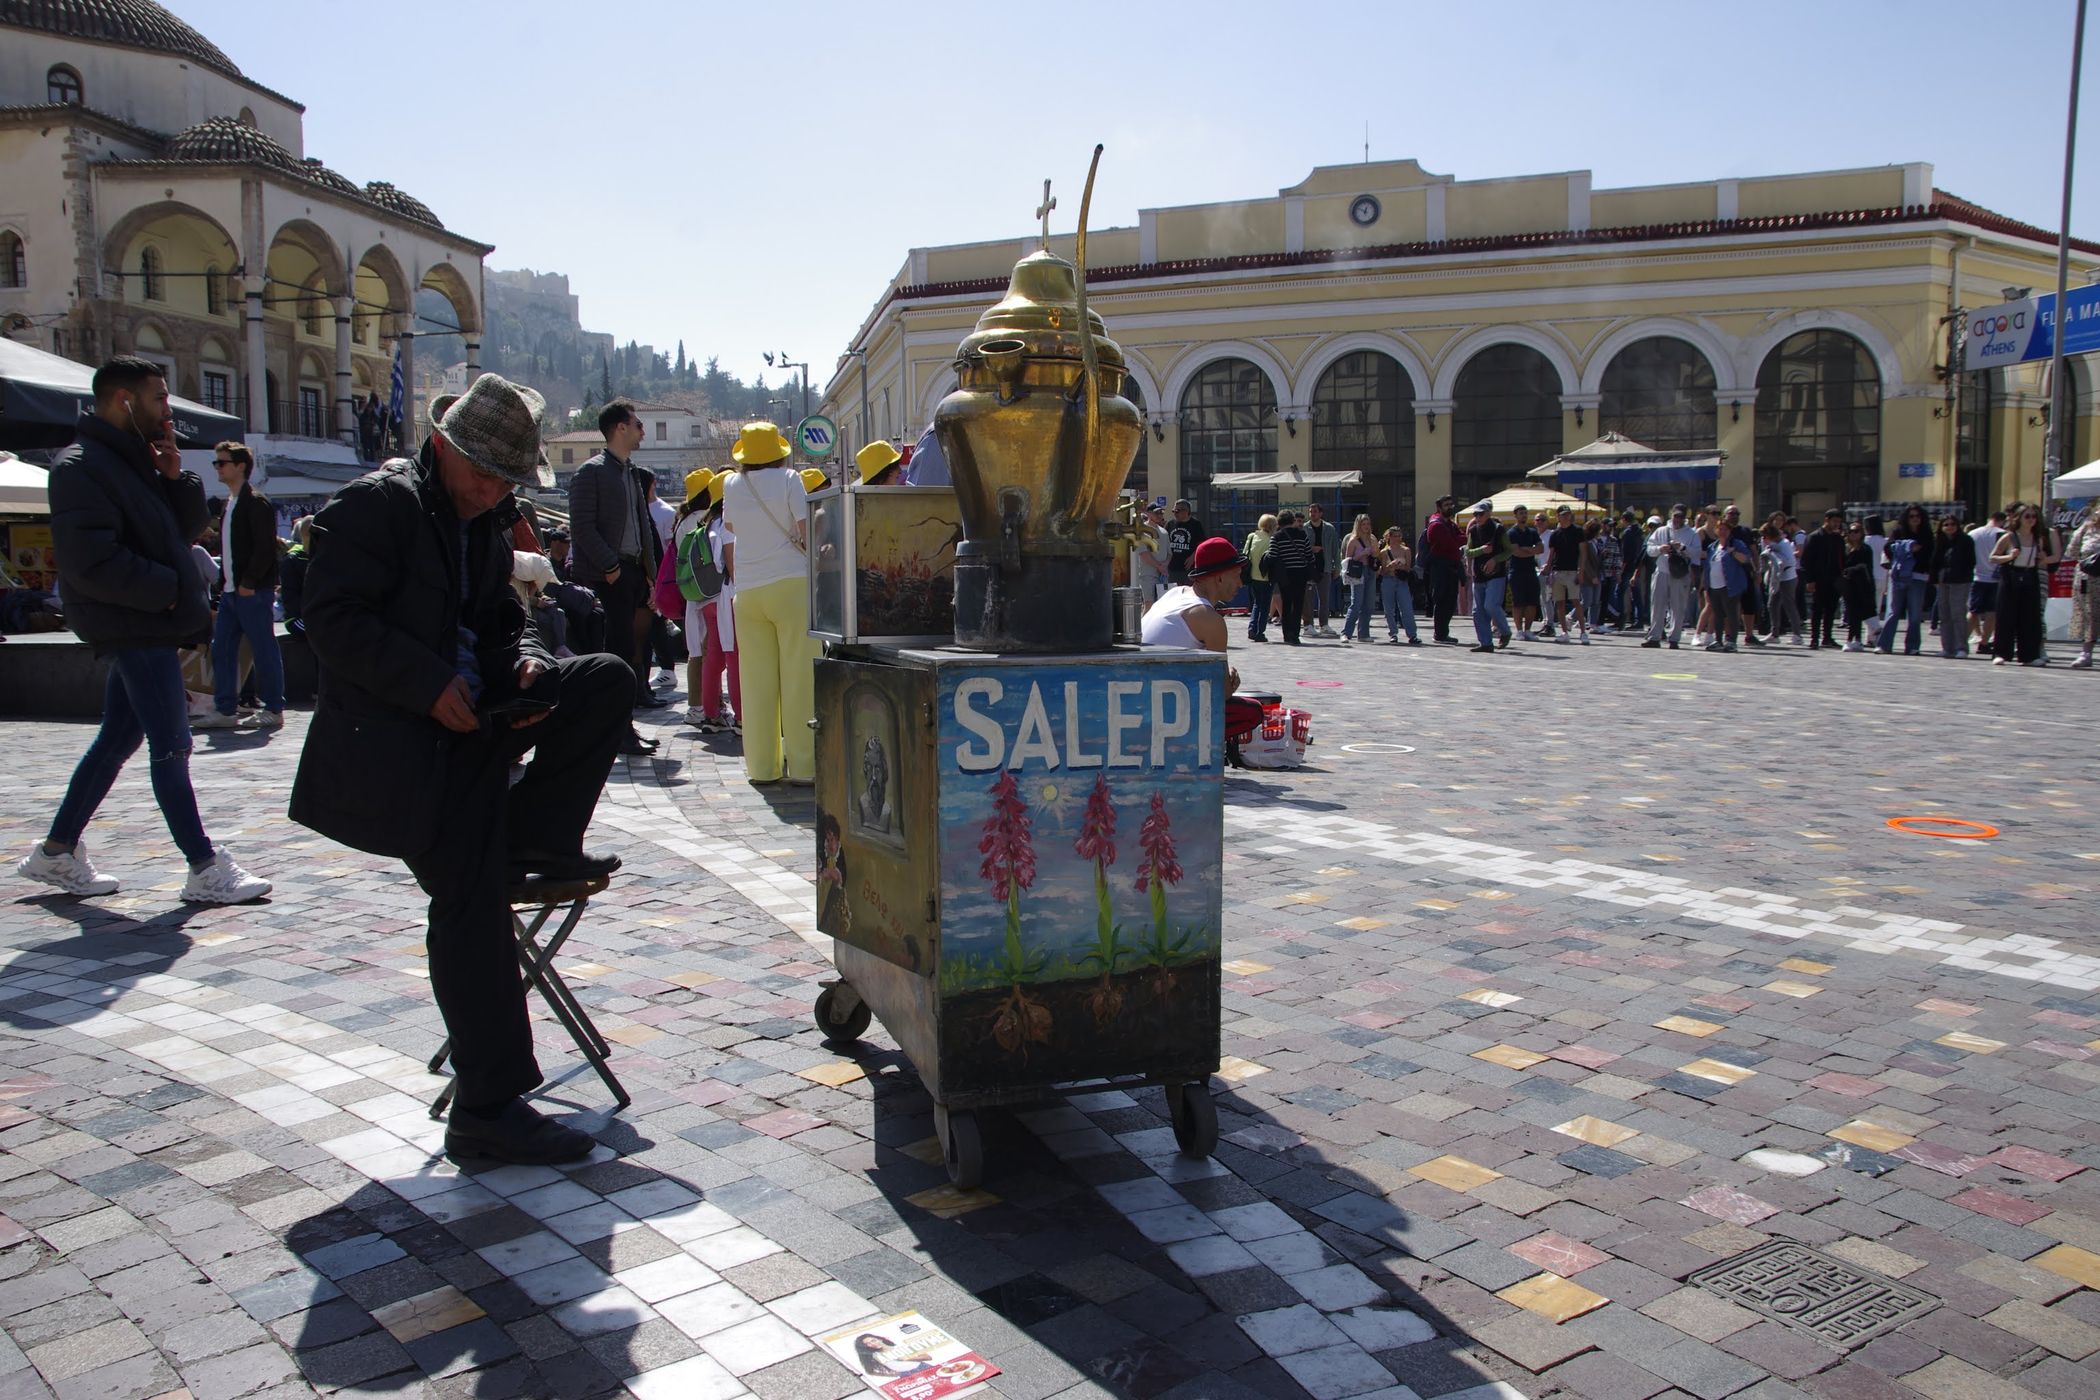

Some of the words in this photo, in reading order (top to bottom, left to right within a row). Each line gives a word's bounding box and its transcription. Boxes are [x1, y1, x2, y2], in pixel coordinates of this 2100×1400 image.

[1973, 312, 2026, 346] agora
[2042, 307, 2073, 326] FLA
[1981, 341, 2015, 357] ATHENS
[954, 677, 1212, 773] SALEPI
